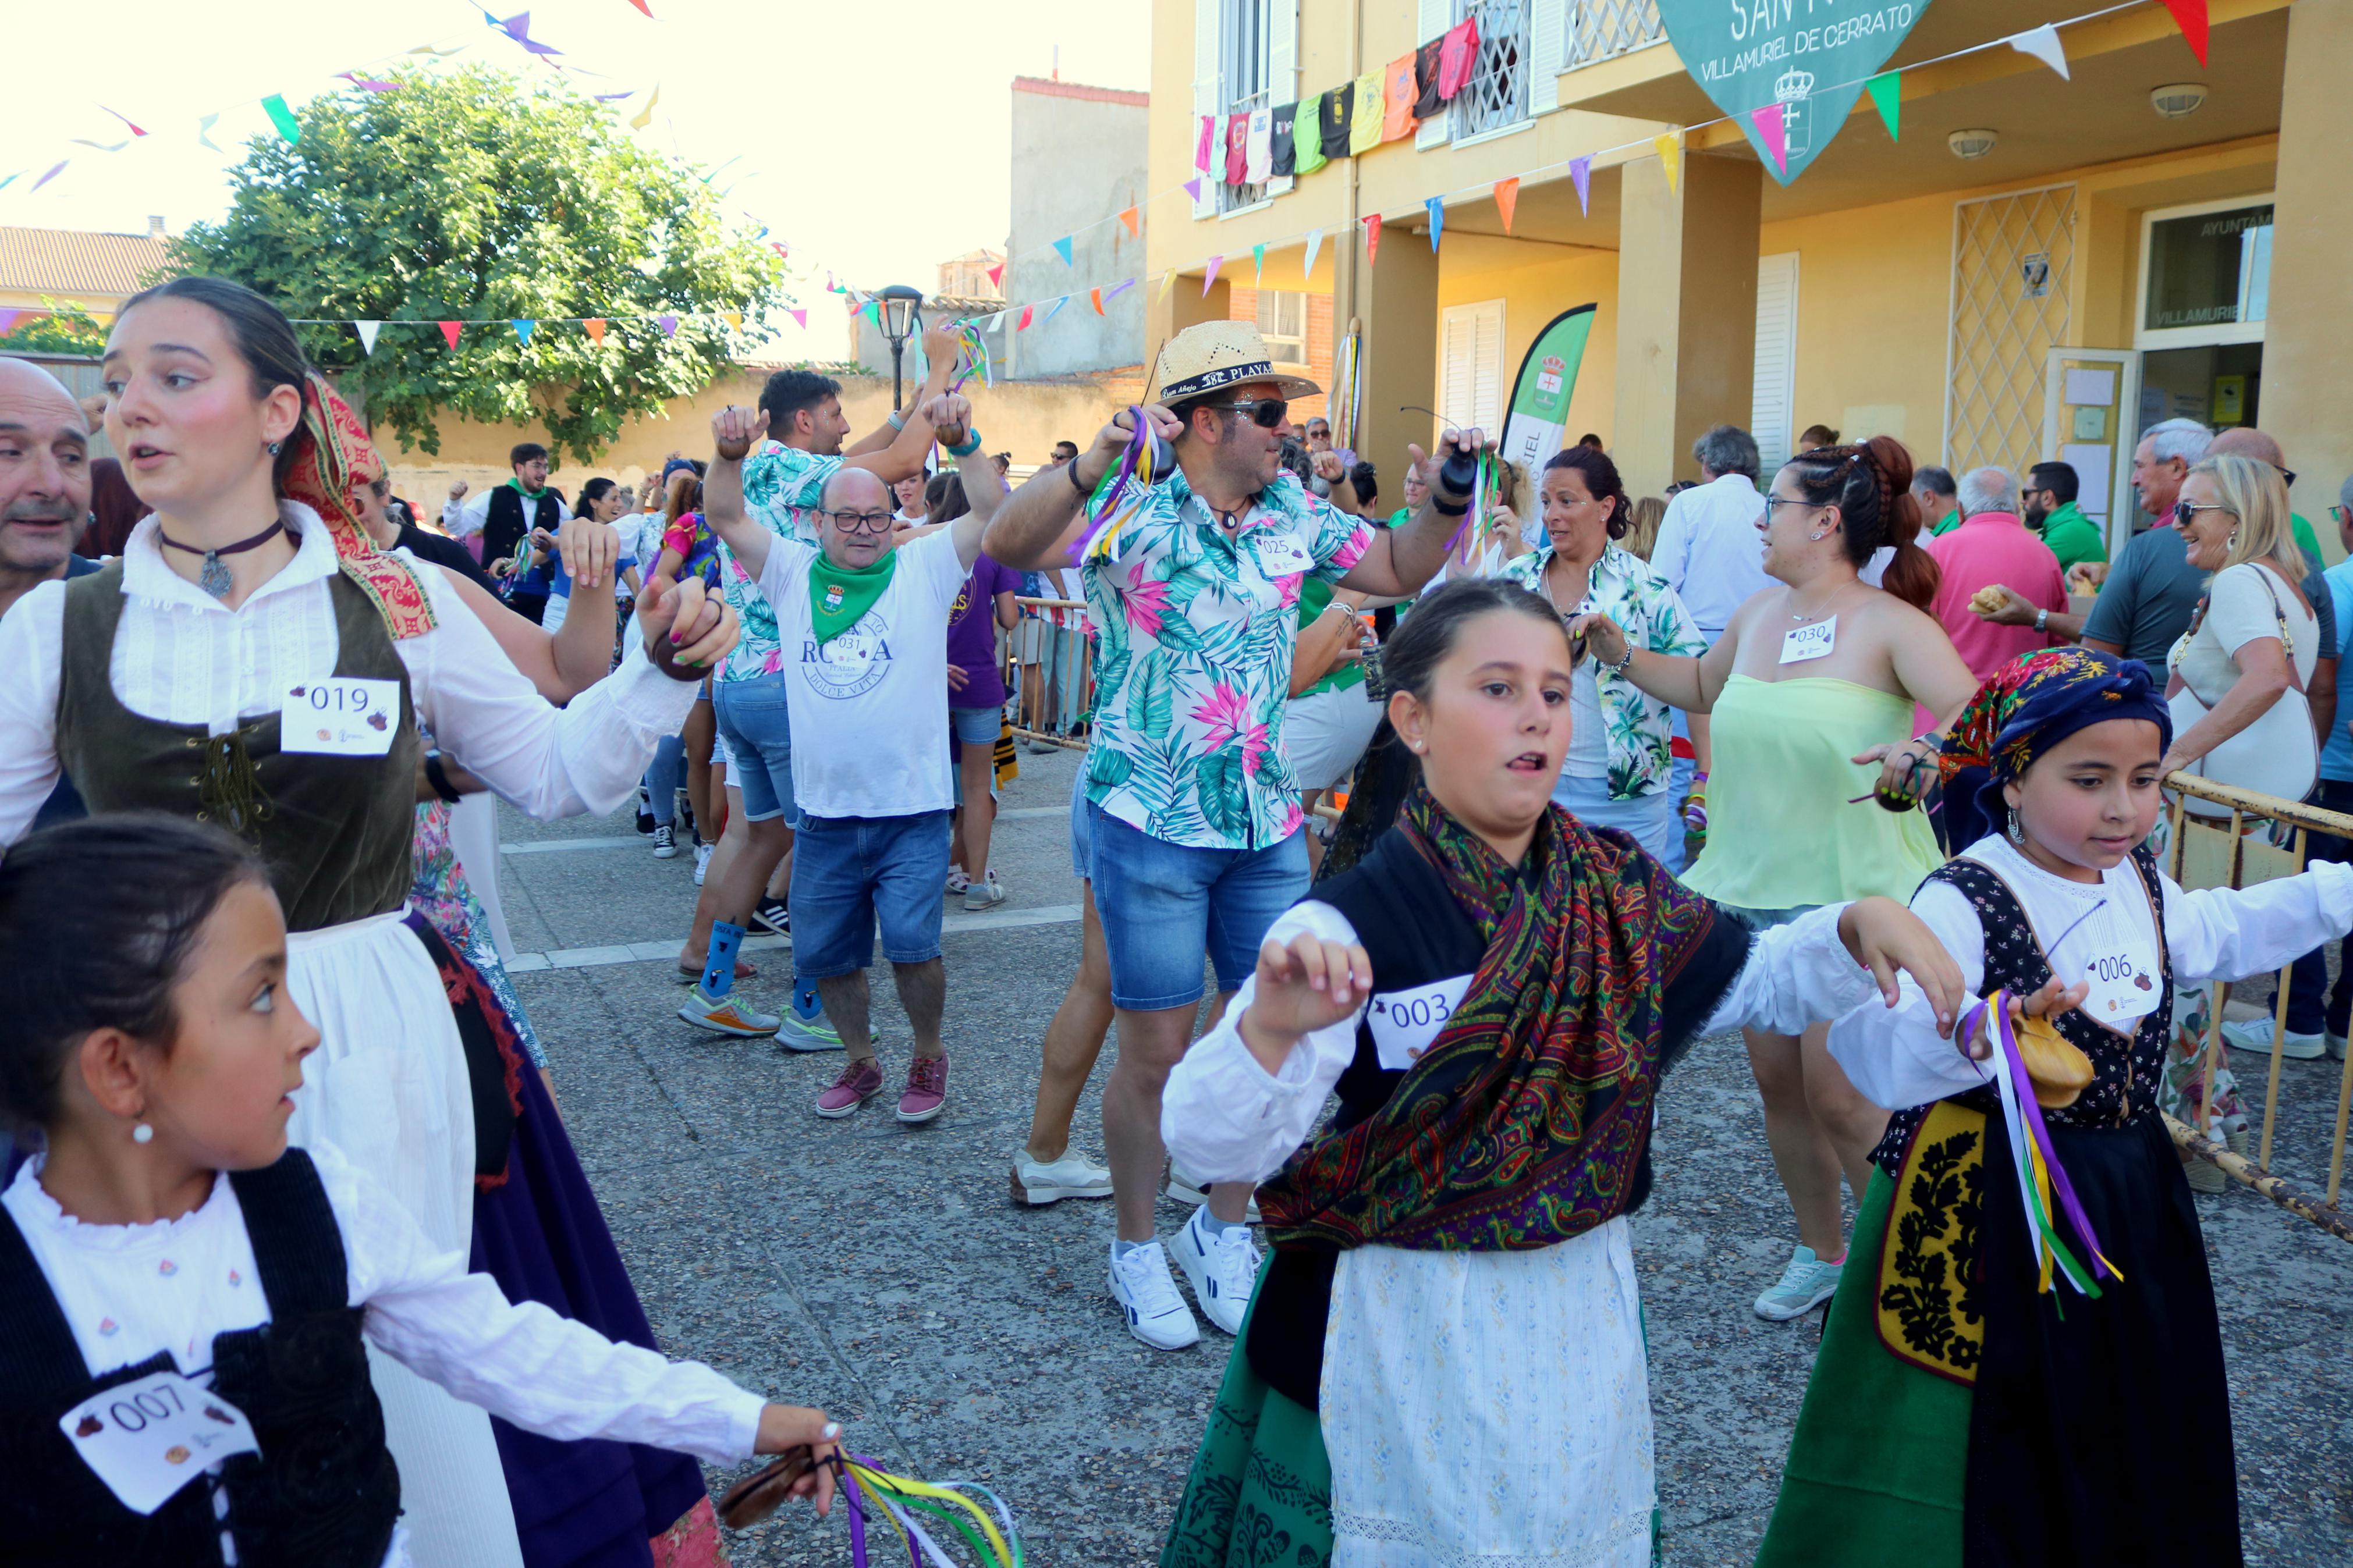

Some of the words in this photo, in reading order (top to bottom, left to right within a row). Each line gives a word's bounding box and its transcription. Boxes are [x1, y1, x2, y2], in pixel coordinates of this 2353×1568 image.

[1702, 36, 1791, 81] VILLAMURIEL
[1794, 27, 1821, 54] DE
[1823, 3, 1912, 48] CERRATO
[2201, 214, 2273, 237] AYUNTAM
[2157, 305, 2240, 325] VILLAMURIE
[1178, 383, 1197, 393] Añejo
[1263, 540, 1289, 553] 025
[839, 637, 860, 650] 031
[1797, 625, 1826, 642] 030
[799, 639, 893, 664] ROA
[810, 673, 844, 697] DOLCE
[849, 671, 881, 694] VITA
[310, 687, 369, 712] 019
[2099, 954, 2132, 982] 006
[1392, 994, 1451, 1028] 003
[110, 1385, 185, 1432] 007
